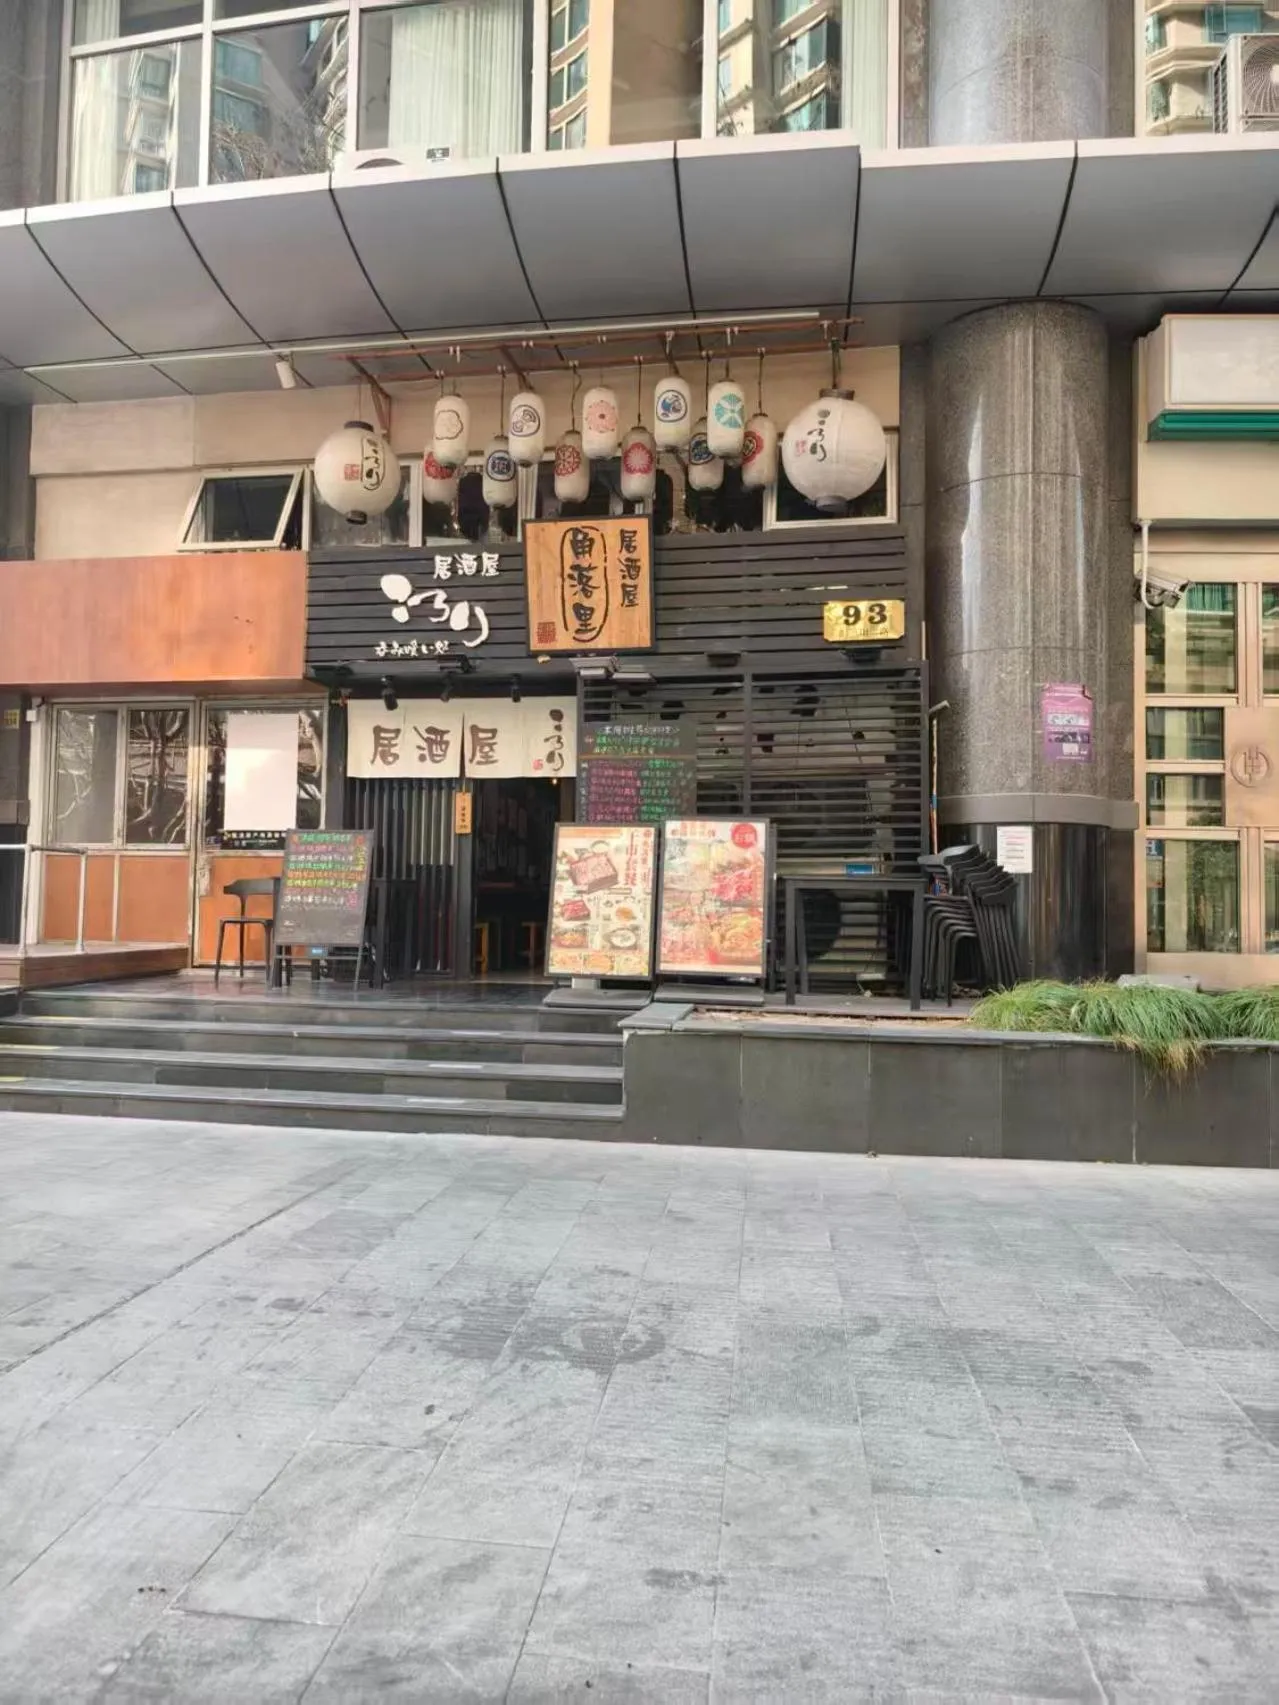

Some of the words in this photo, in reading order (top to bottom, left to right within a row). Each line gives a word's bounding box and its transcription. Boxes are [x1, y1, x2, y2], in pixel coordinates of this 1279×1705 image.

[433, 551, 500, 580] 居酒屋
[567, 527, 601, 635] 角落里
[617, 528, 642, 608] 居酒屋
[842, 603, 888, 627] 93
[370, 724, 499, 766] 居酒屋
